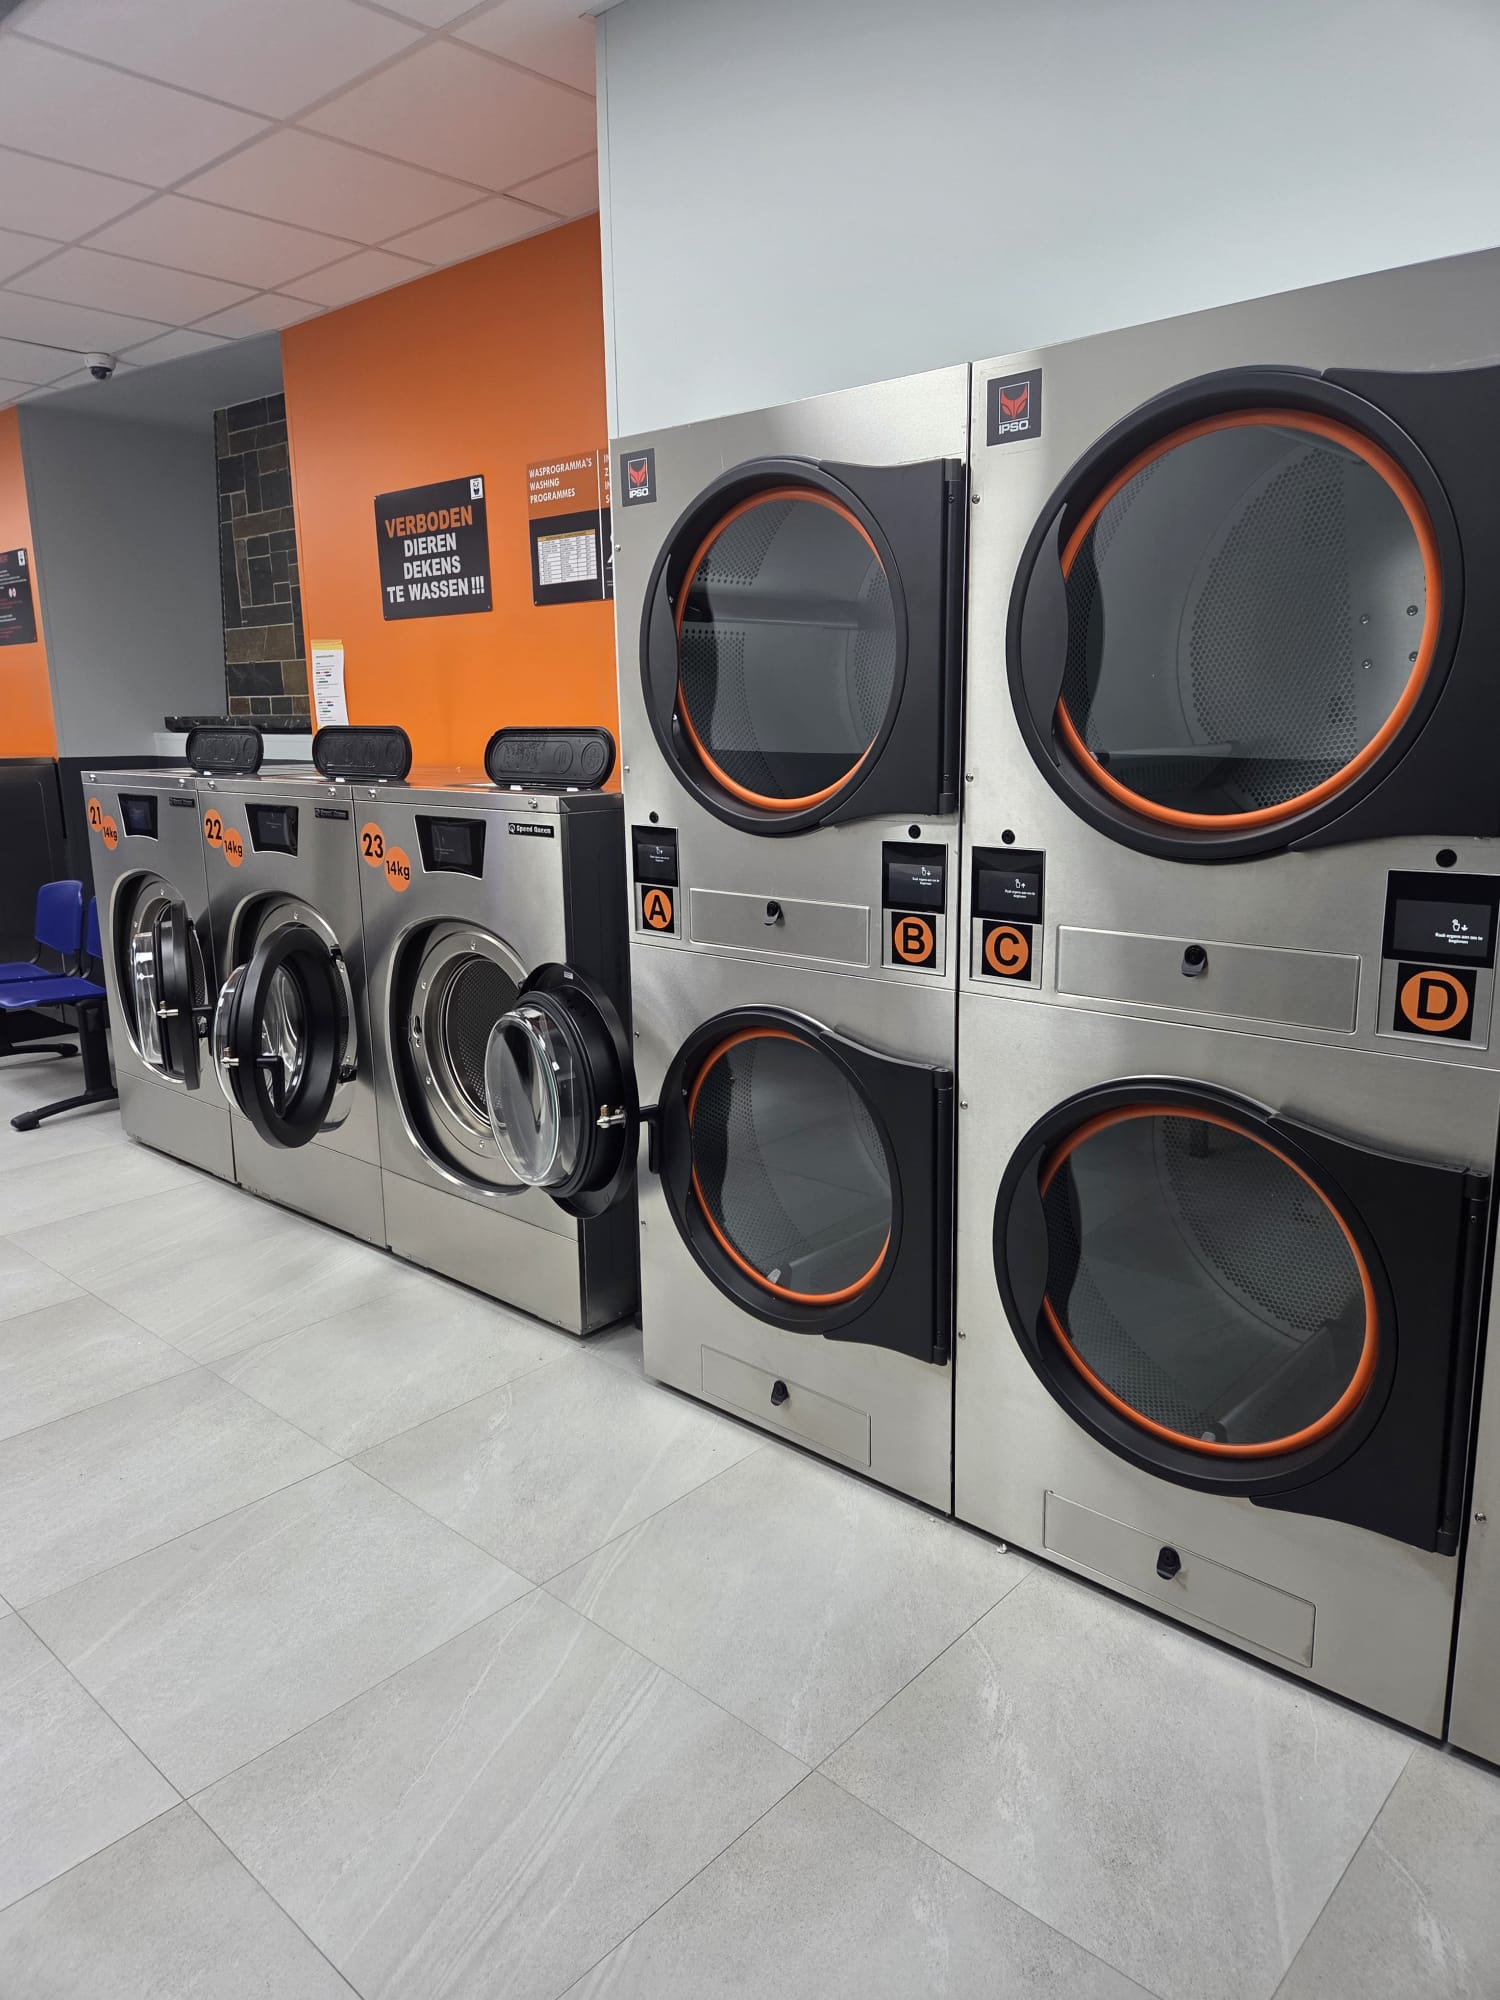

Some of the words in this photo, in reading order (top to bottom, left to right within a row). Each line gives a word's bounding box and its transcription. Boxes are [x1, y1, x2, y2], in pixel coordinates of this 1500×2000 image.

[999, 420, 1029, 434] IPSO
[529, 457, 592, 479] WASPROGRAMMA'S
[530, 478, 560, 491] WASHING
[629, 488, 648, 499] IPSO
[530, 488, 576, 504] PROGRAMMES
[385, 505, 473, 538] VERBODEN
[403, 532, 457, 557] DIEREN
[403, 555, 461, 580] DEKENS
[387, 585, 405, 603] TE
[408, 577, 469, 601] WASSEN
[89, 806, 102, 825] 21
[102, 826, 118, 841] 14kg
[205, 818, 223, 840] 22
[224, 840, 243, 857] 14kg
[362, 832, 384, 858] 23
[385, 860, 410, 881] 14kg
[649, 894, 668, 923] A
[902, 922, 926, 955] B
[993, 932, 1020, 966] C
[1416, 977, 1458, 1021] D
